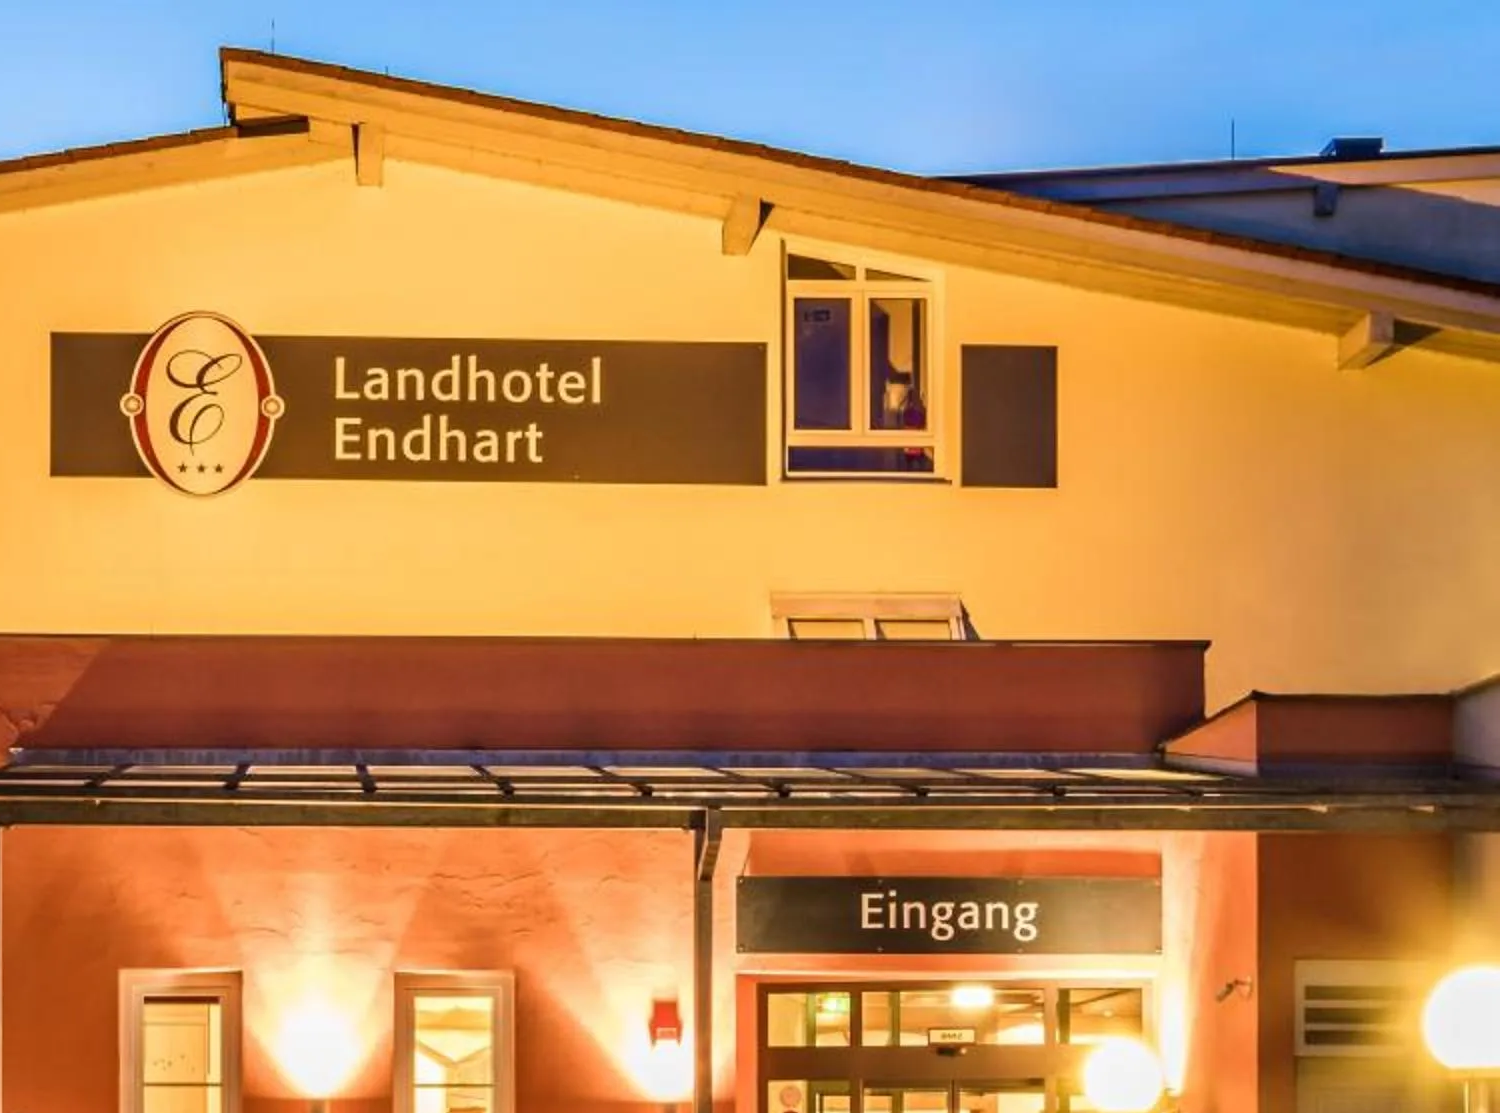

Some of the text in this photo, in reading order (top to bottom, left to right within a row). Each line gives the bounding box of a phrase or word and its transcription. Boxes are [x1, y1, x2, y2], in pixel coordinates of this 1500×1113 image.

[334, 354, 601, 404] Landhotel
[334, 414, 543, 463] Endhart
[861, 890, 1039, 941] Eingang
